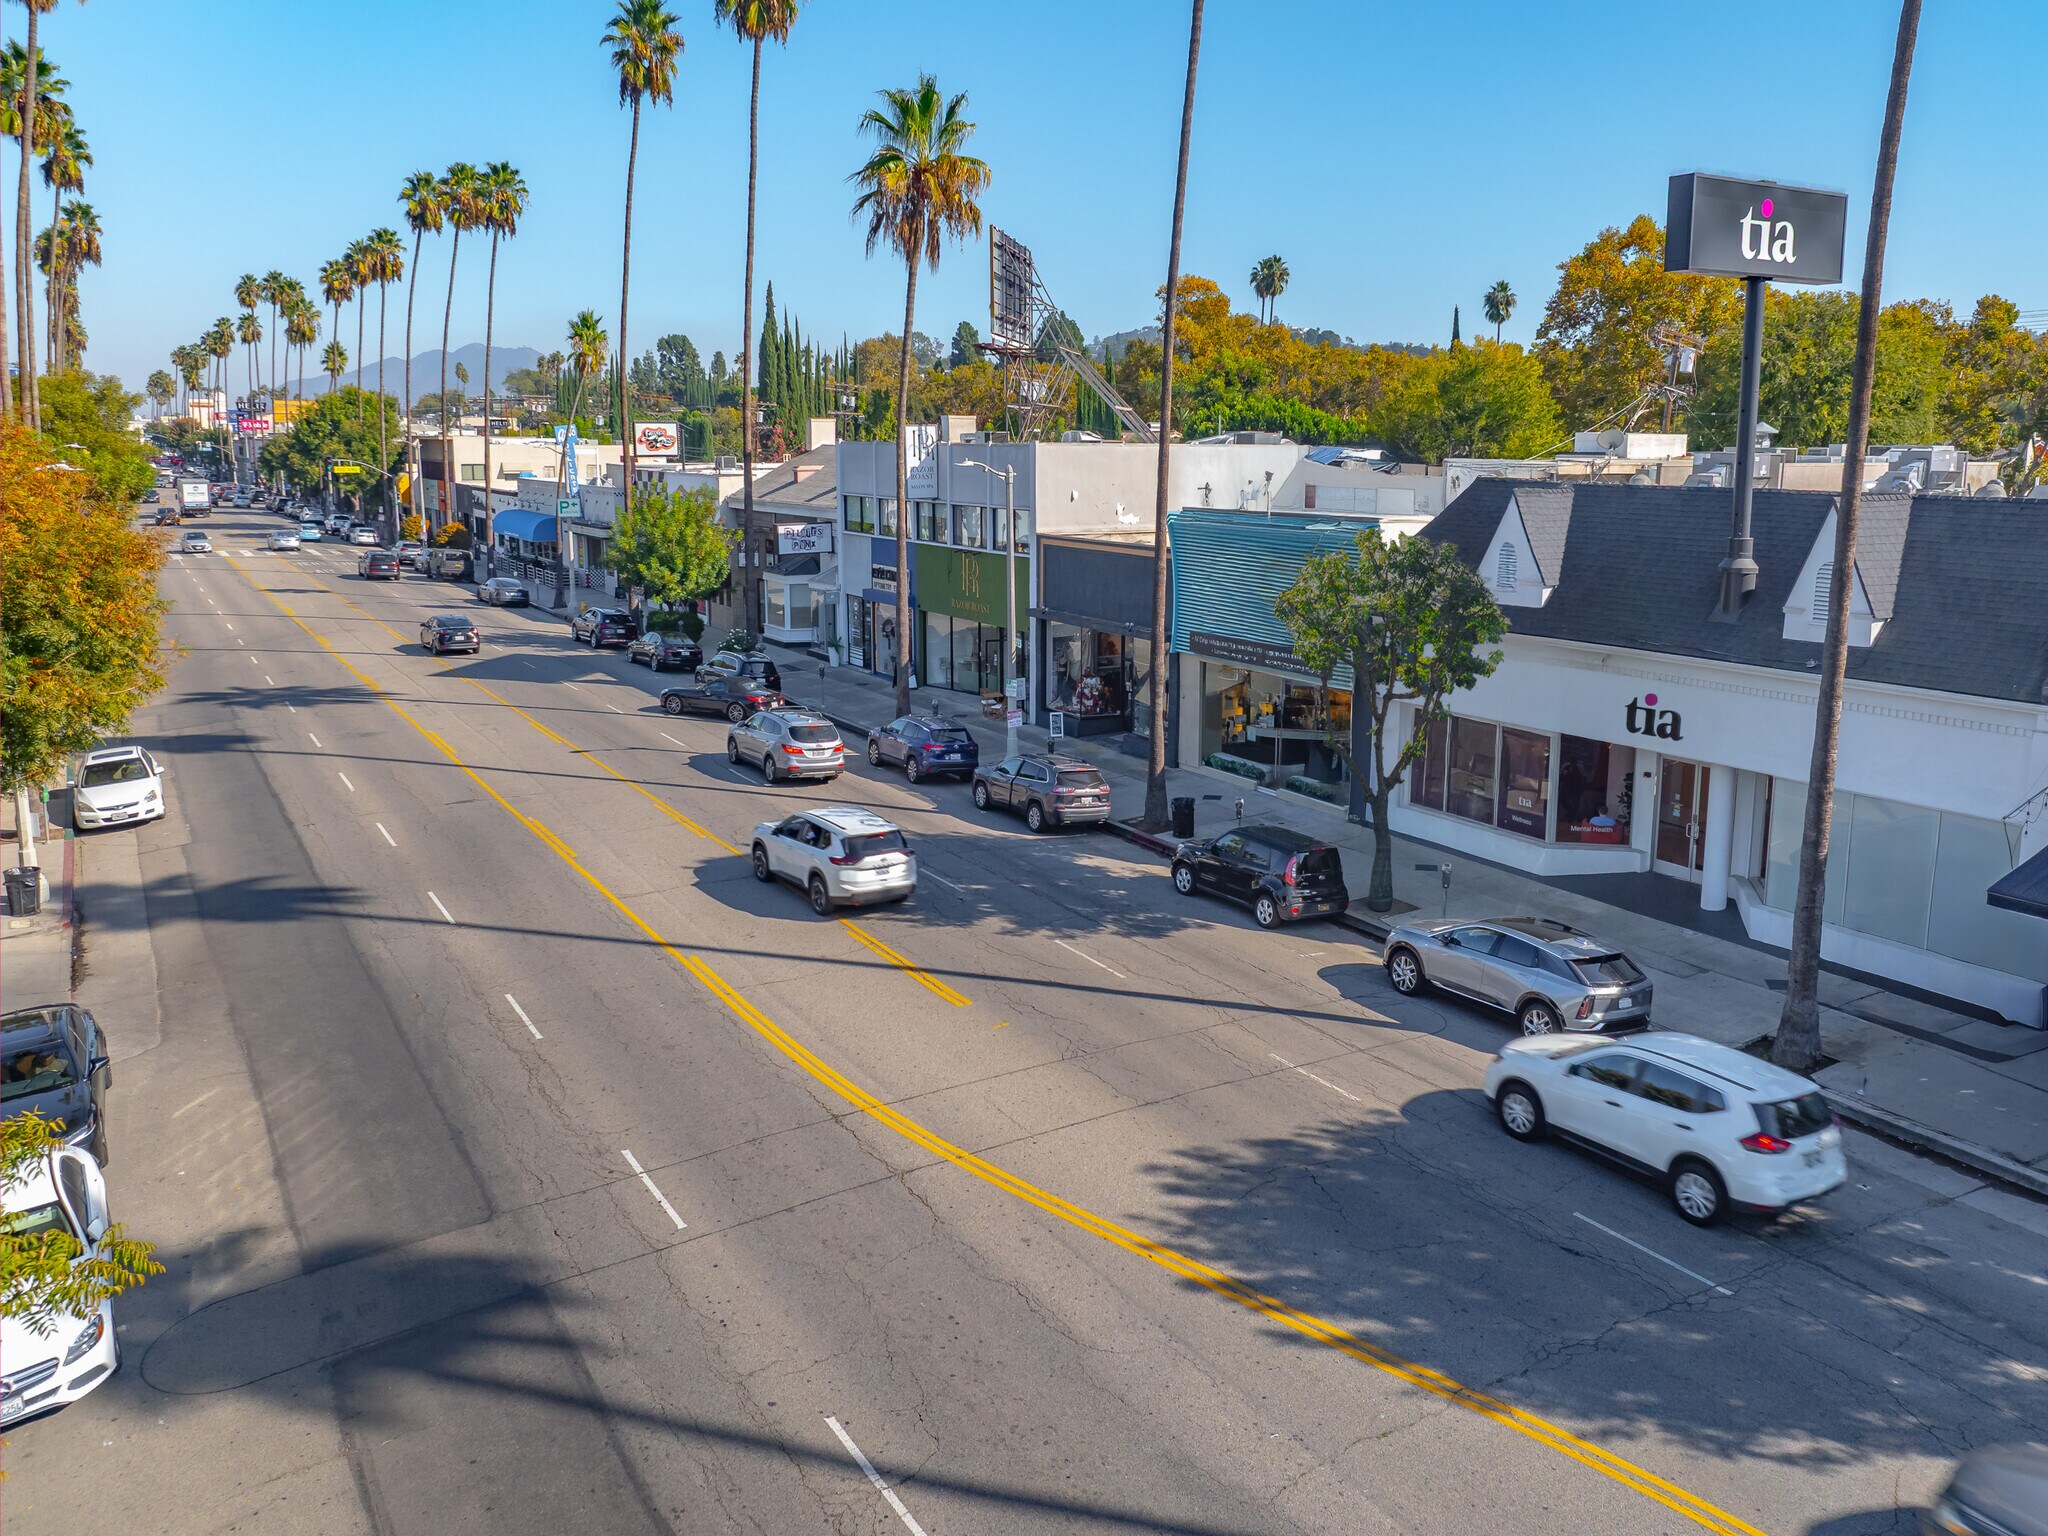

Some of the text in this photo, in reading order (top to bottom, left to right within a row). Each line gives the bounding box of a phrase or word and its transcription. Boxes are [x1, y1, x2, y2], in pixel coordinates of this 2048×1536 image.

[1740, 198, 1797, 264] tia
[1624, 693, 1684, 742] tia
[1518, 796, 1532, 808] tia
[1512, 814, 1532, 826] Wellness
